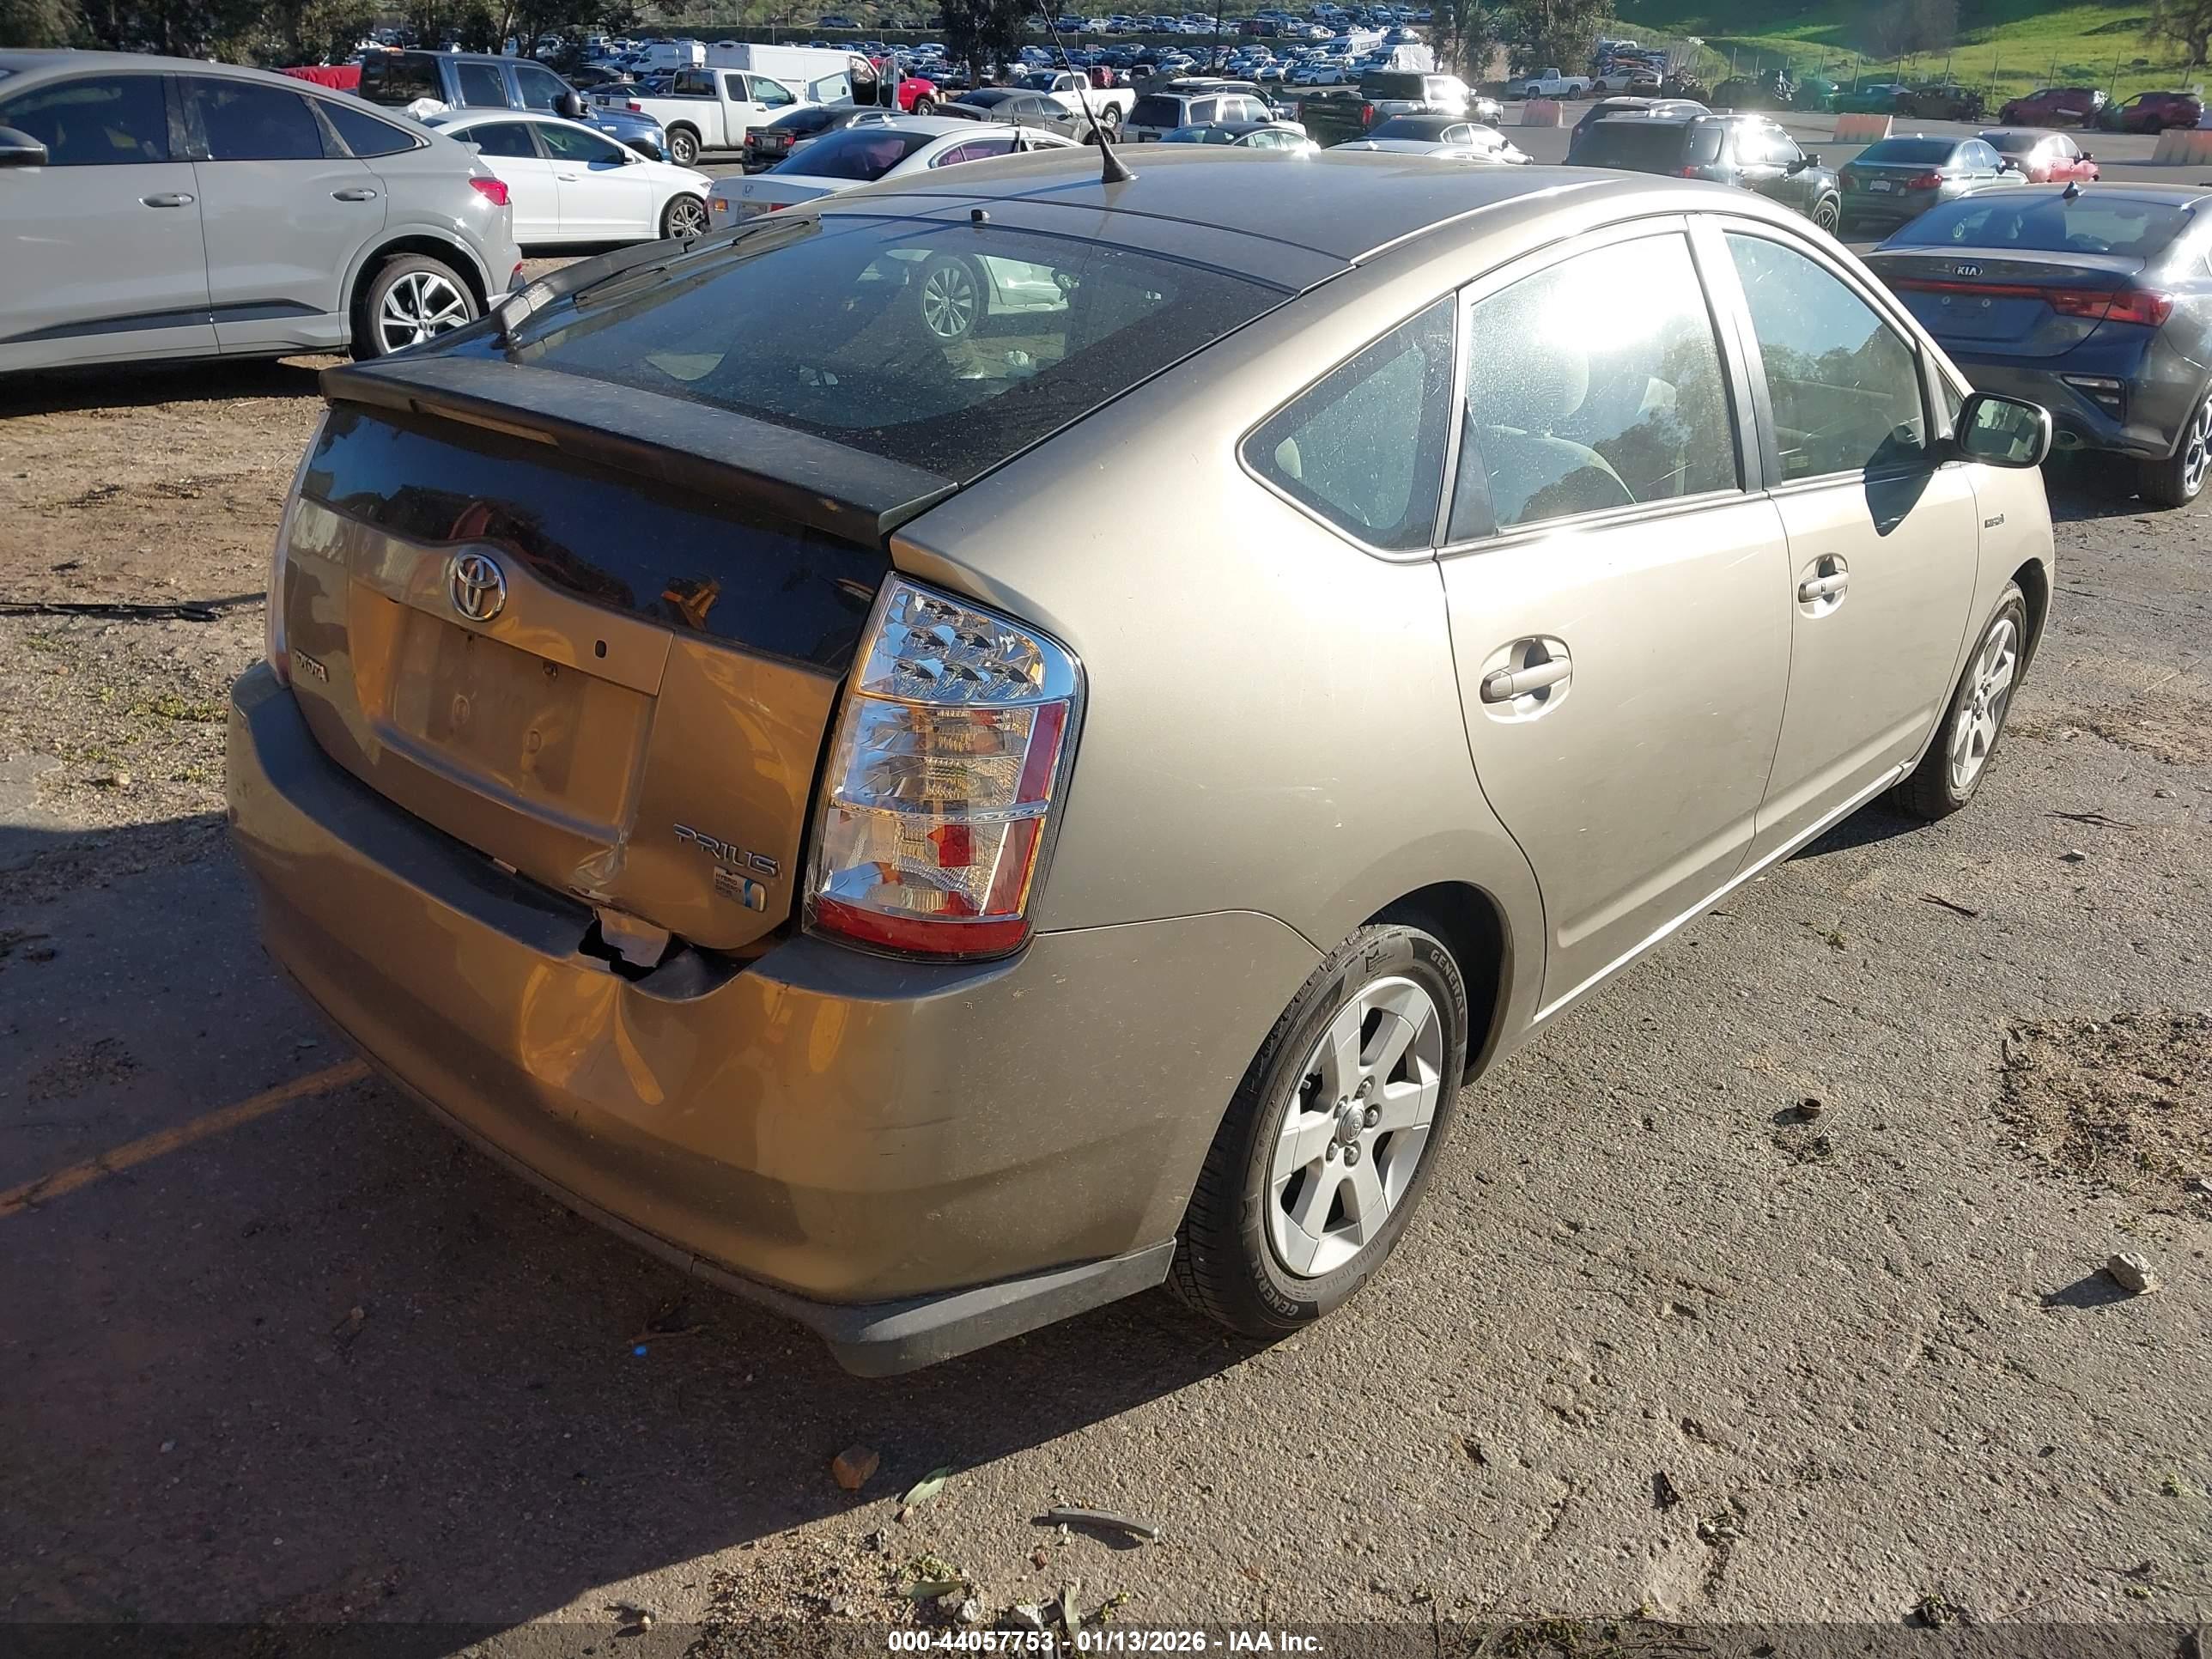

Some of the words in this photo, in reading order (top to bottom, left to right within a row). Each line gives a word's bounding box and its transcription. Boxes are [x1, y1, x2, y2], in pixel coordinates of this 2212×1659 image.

[1957, 266, 1977, 276] KIA
[673, 823, 781, 877] PRIUS
[715, 872, 738, 886] HYBRID
[1429, 948, 1466, 1020] GENERAL
[1250, 1255, 1299, 1317] GENERAL
